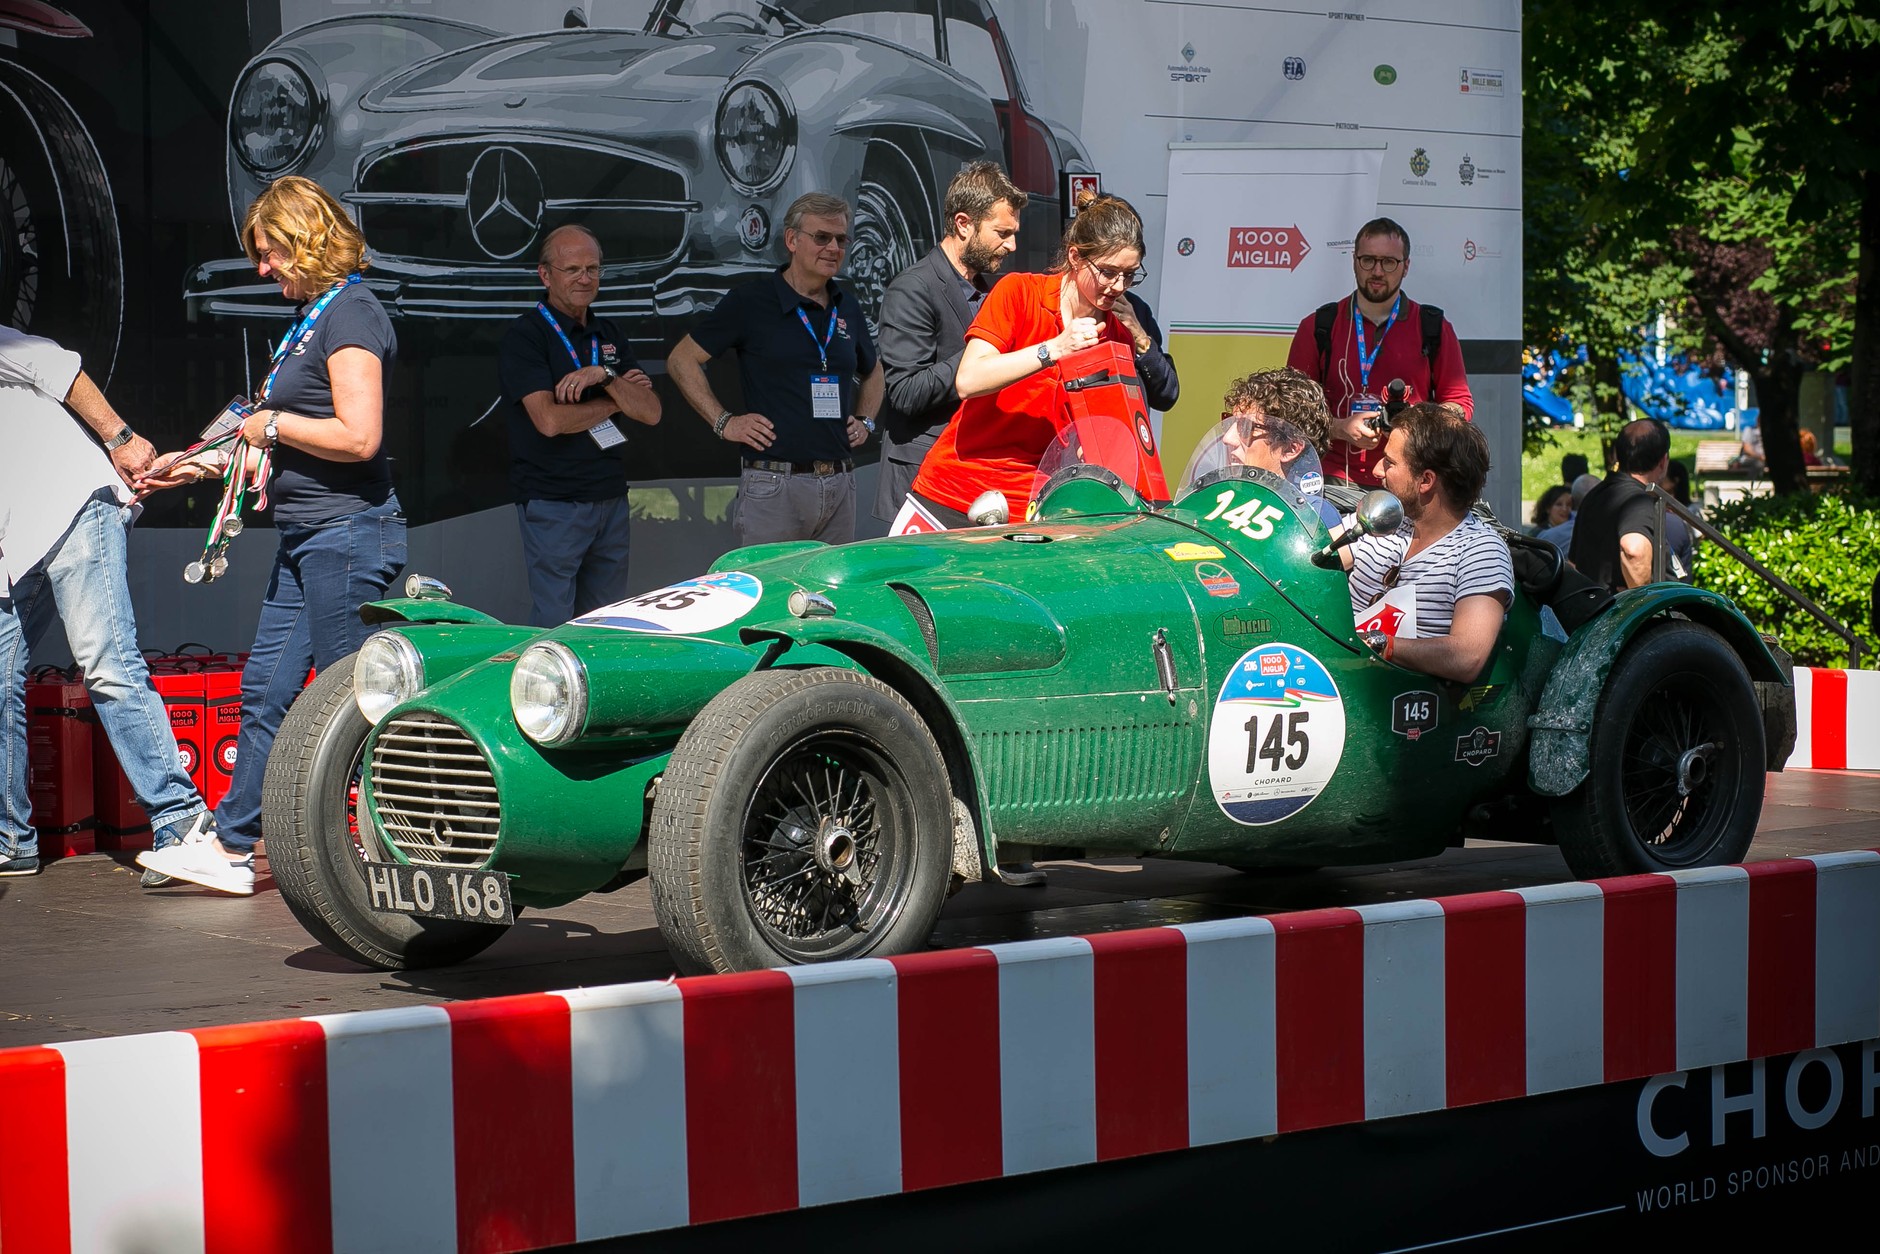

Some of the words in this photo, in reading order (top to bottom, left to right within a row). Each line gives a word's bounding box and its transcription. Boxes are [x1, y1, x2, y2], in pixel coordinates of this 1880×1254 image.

[1284, 62, 1303, 75] FIA
[1170, 73, 1207, 83] SPORT
[1237, 231, 1288, 245] 1000
[1231, 250, 1291, 265] MIGLIA
[1204, 490, 1285, 541] 145
[1263, 656, 1282, 664] 1000
[1404, 701, 1429, 721] 145
[171, 718, 194, 726] MIGLIA
[770, 702, 822, 745] DUNLOP
[827, 700, 876, 719] RACING
[1244, 711, 1310, 774] 145
[180, 754, 189, 764] 52
[227, 750, 236, 760] 52
[1463, 748, 1492, 757] CHOPARD
[1254, 777, 1292, 785] CHOPARD
[368, 866, 435, 912] HLO
[448, 873, 505, 919] 168
[1637, 1177, 1716, 1213] WORLD
[1727, 1154, 1829, 1195] SPONSOR
[1840, 1144, 1880, 1172] AND
